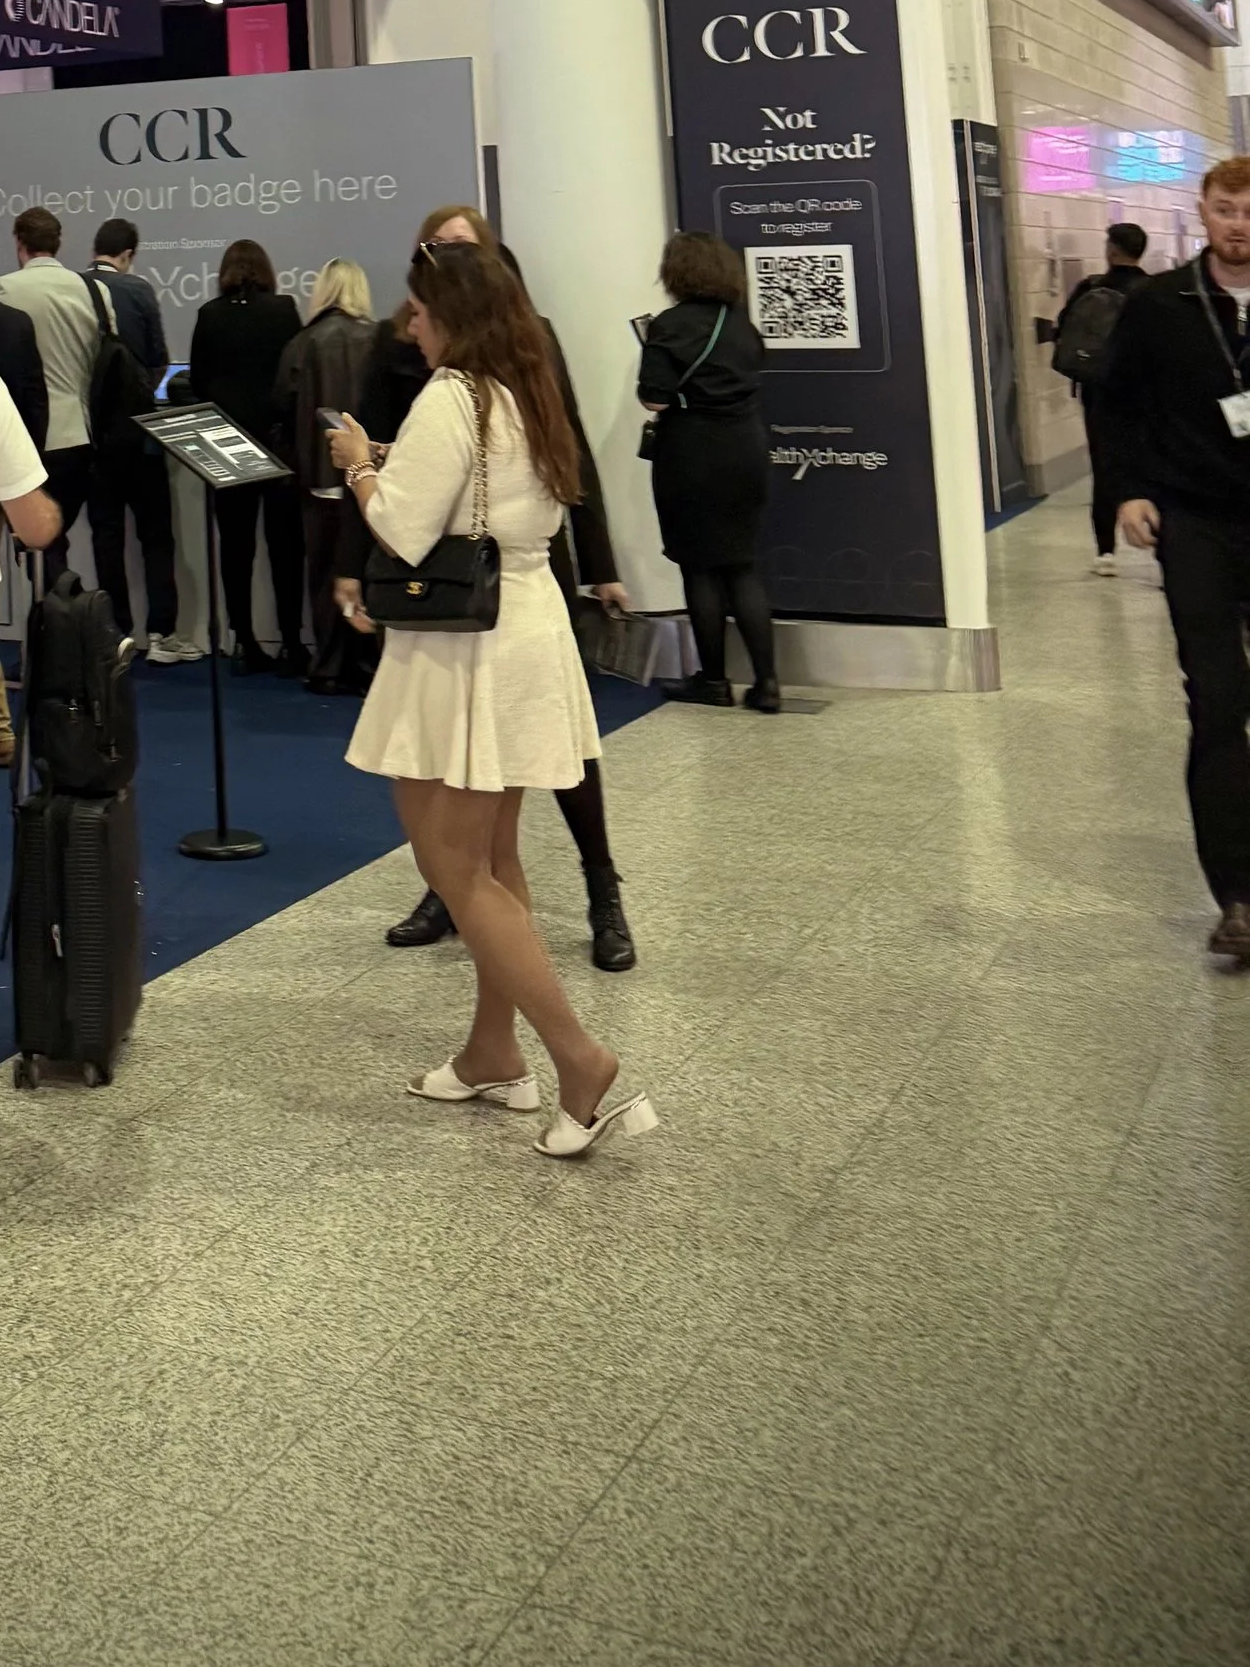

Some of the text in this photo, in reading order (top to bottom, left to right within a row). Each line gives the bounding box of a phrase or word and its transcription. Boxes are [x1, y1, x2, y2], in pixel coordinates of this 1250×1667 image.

[702, 7, 868, 63] CCR
[99, 107, 247, 166] CCR
[760, 106, 817, 131] Not
[710, 133, 876, 171] Registered?
[103, 184, 180, 220] your
[189, 173, 302, 215] badge
[313, 169, 398, 203] here
[729, 197, 863, 214] Scan the QR code
